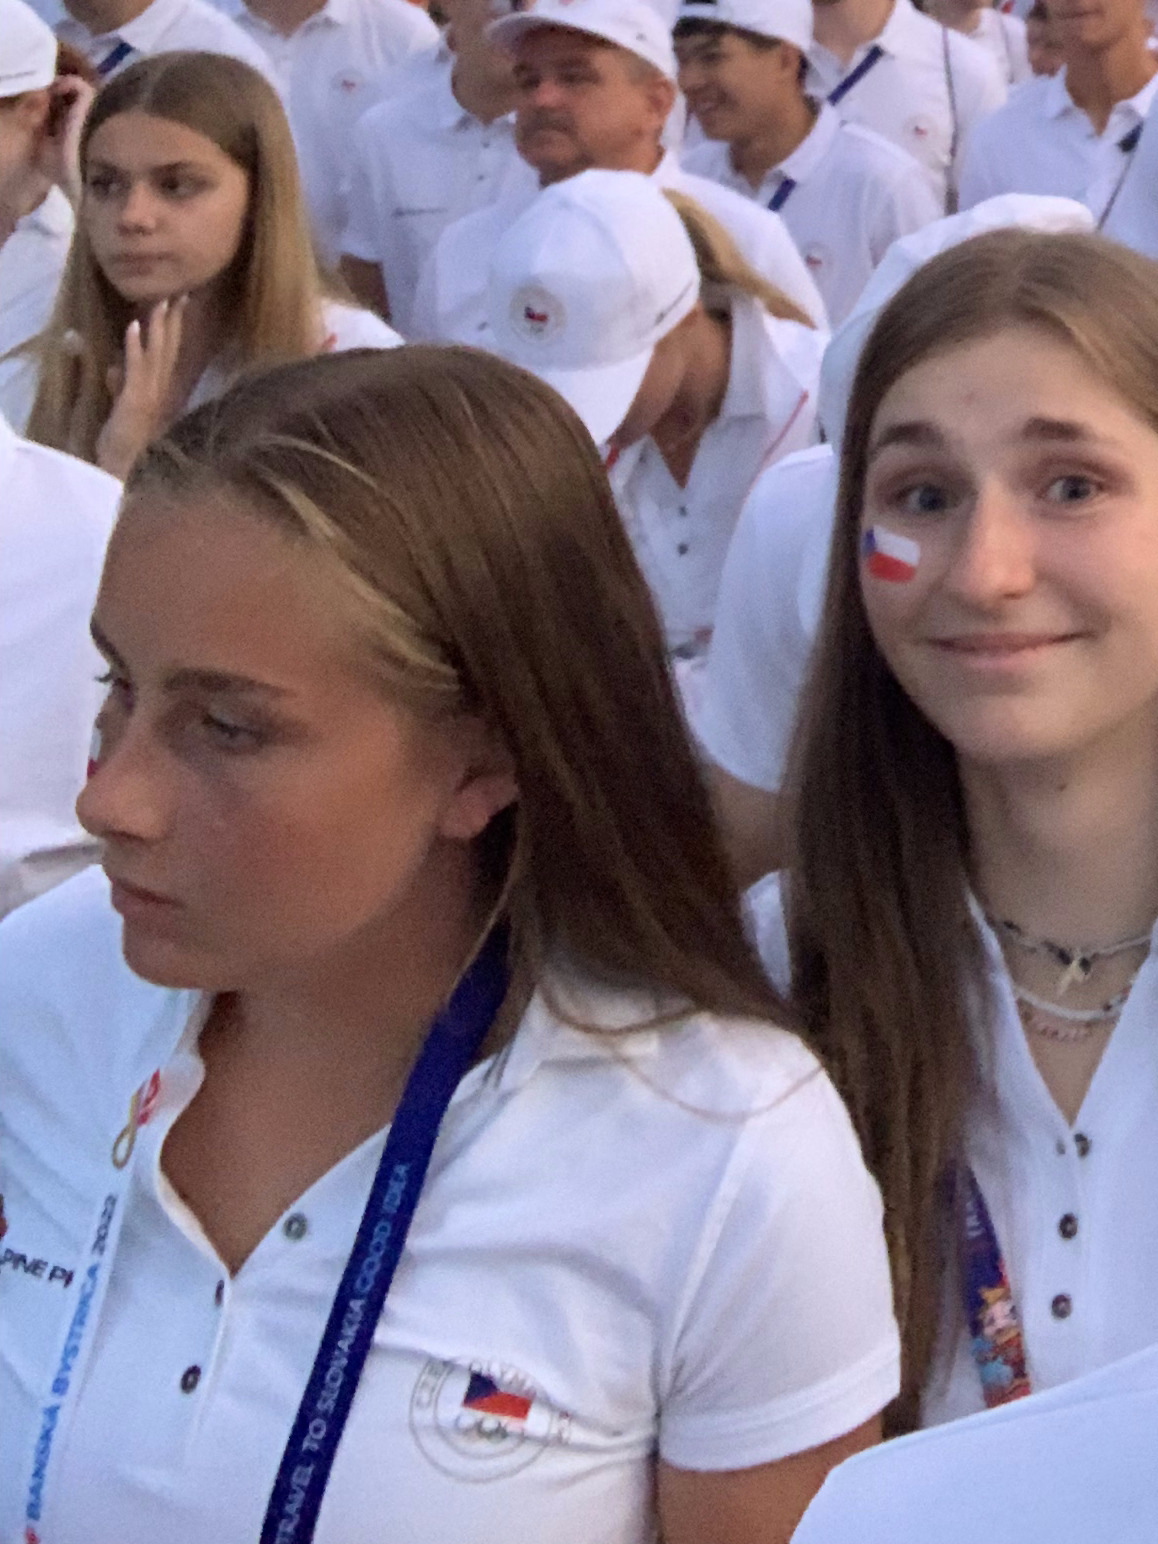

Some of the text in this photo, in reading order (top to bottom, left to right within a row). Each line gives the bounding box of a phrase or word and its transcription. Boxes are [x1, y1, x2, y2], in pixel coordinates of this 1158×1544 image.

[274, 1460, 315, 1544] TRAVEL
[301, 1418, 328, 1453] TO
[317, 1298, 366, 1417] SLOVAKIA
[354, 1220, 392, 1295] GOOD
